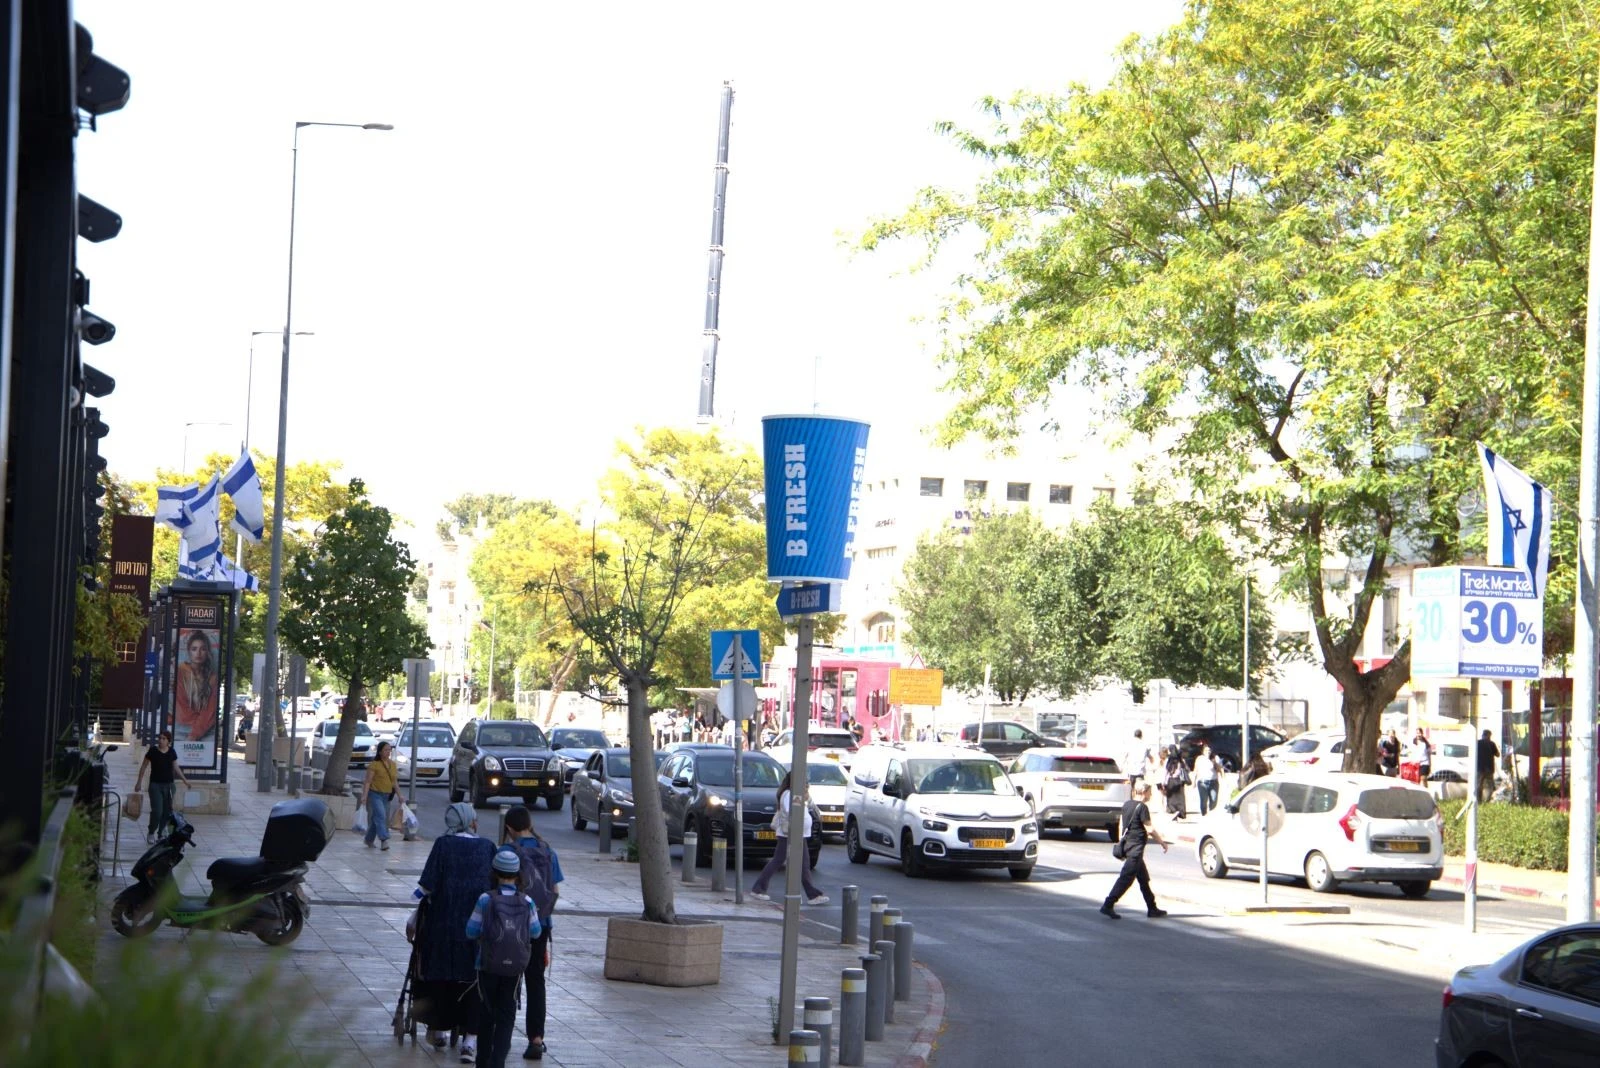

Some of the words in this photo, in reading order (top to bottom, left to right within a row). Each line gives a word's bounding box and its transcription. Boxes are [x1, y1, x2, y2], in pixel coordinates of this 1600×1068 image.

[784, 443, 808, 532] FRESH
[786, 538, 808, 557] B
[115, 561, 148, 576] המרפסת
[1462, 573, 1490, 589] Trek
[1491, 574, 1533, 592] Marke
[188, 608, 214, 618] HADAR
[1462, 600, 1537, 645] 30%
